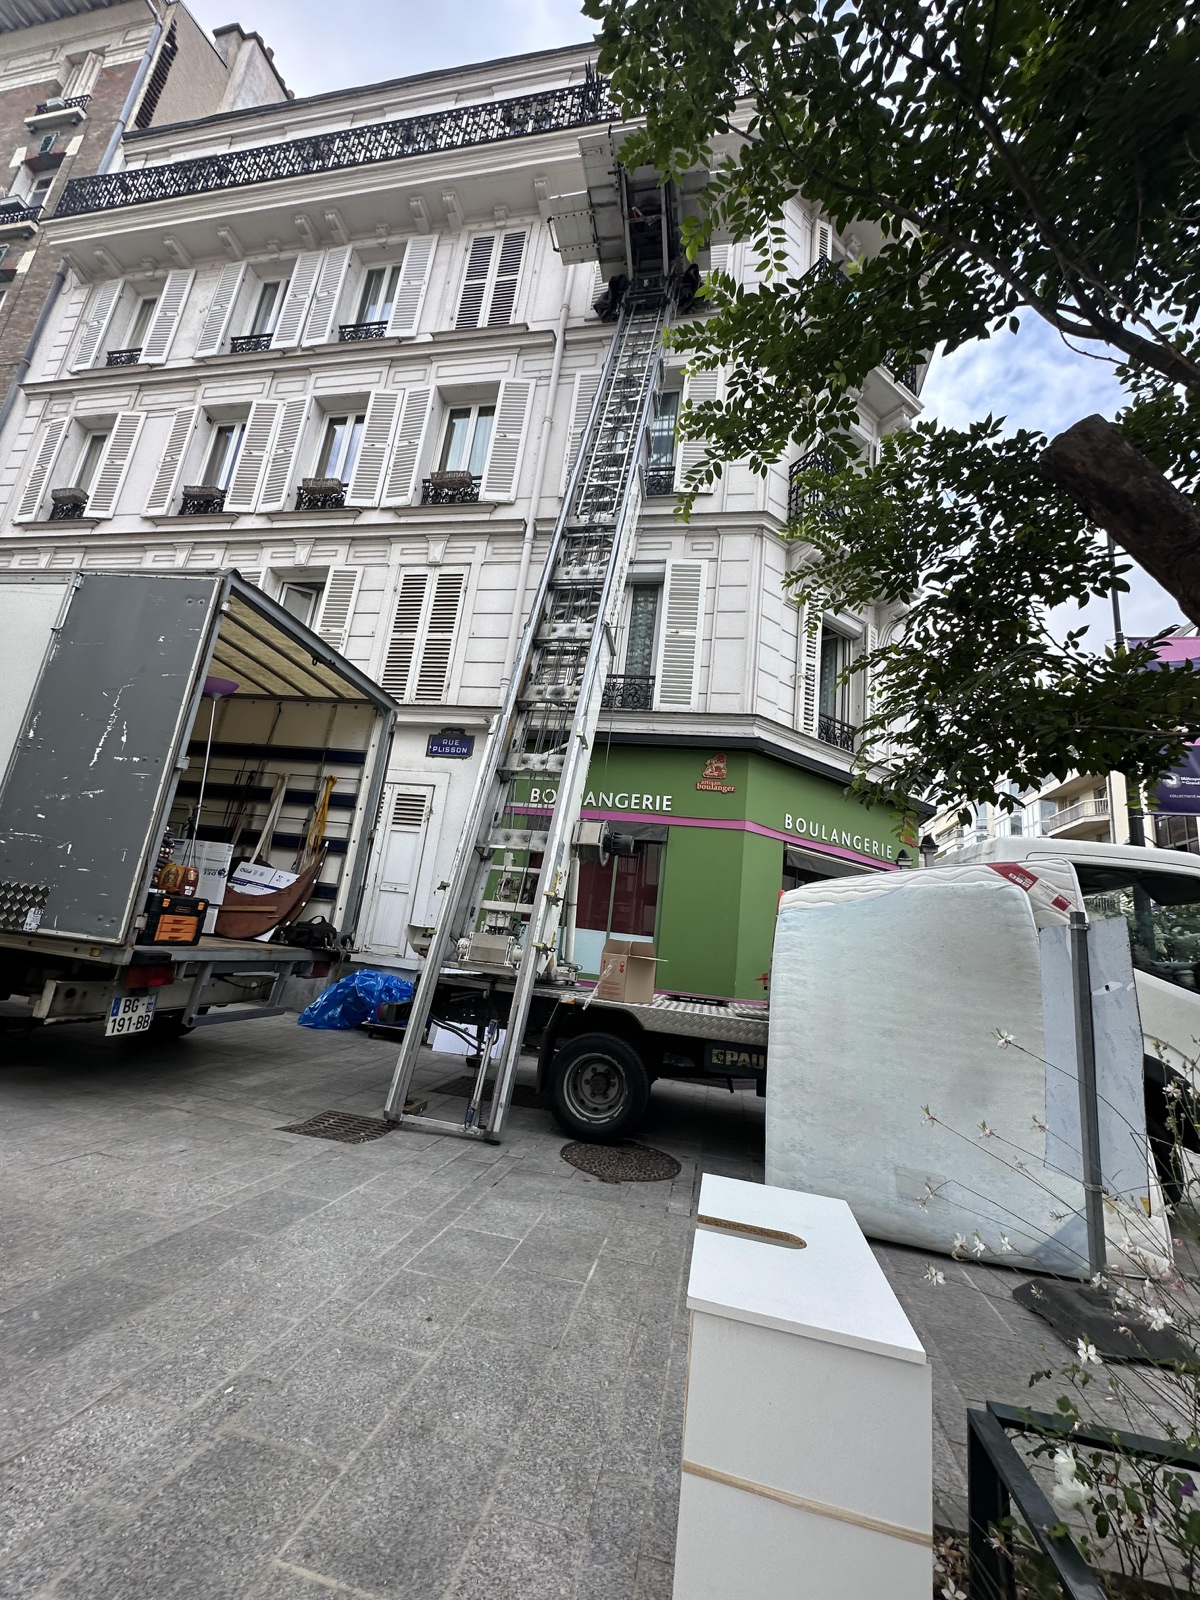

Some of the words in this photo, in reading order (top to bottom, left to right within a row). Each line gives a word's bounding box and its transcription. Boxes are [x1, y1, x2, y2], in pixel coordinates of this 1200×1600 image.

[432, 746, 468, 754] PLISSON
[696, 783, 735, 793] boulanger
[530, 788, 673, 811] BOANGERIE
[785, 813, 893, 859] BOULANGERIE
[111, 1014, 150, 1033] 191-BB
